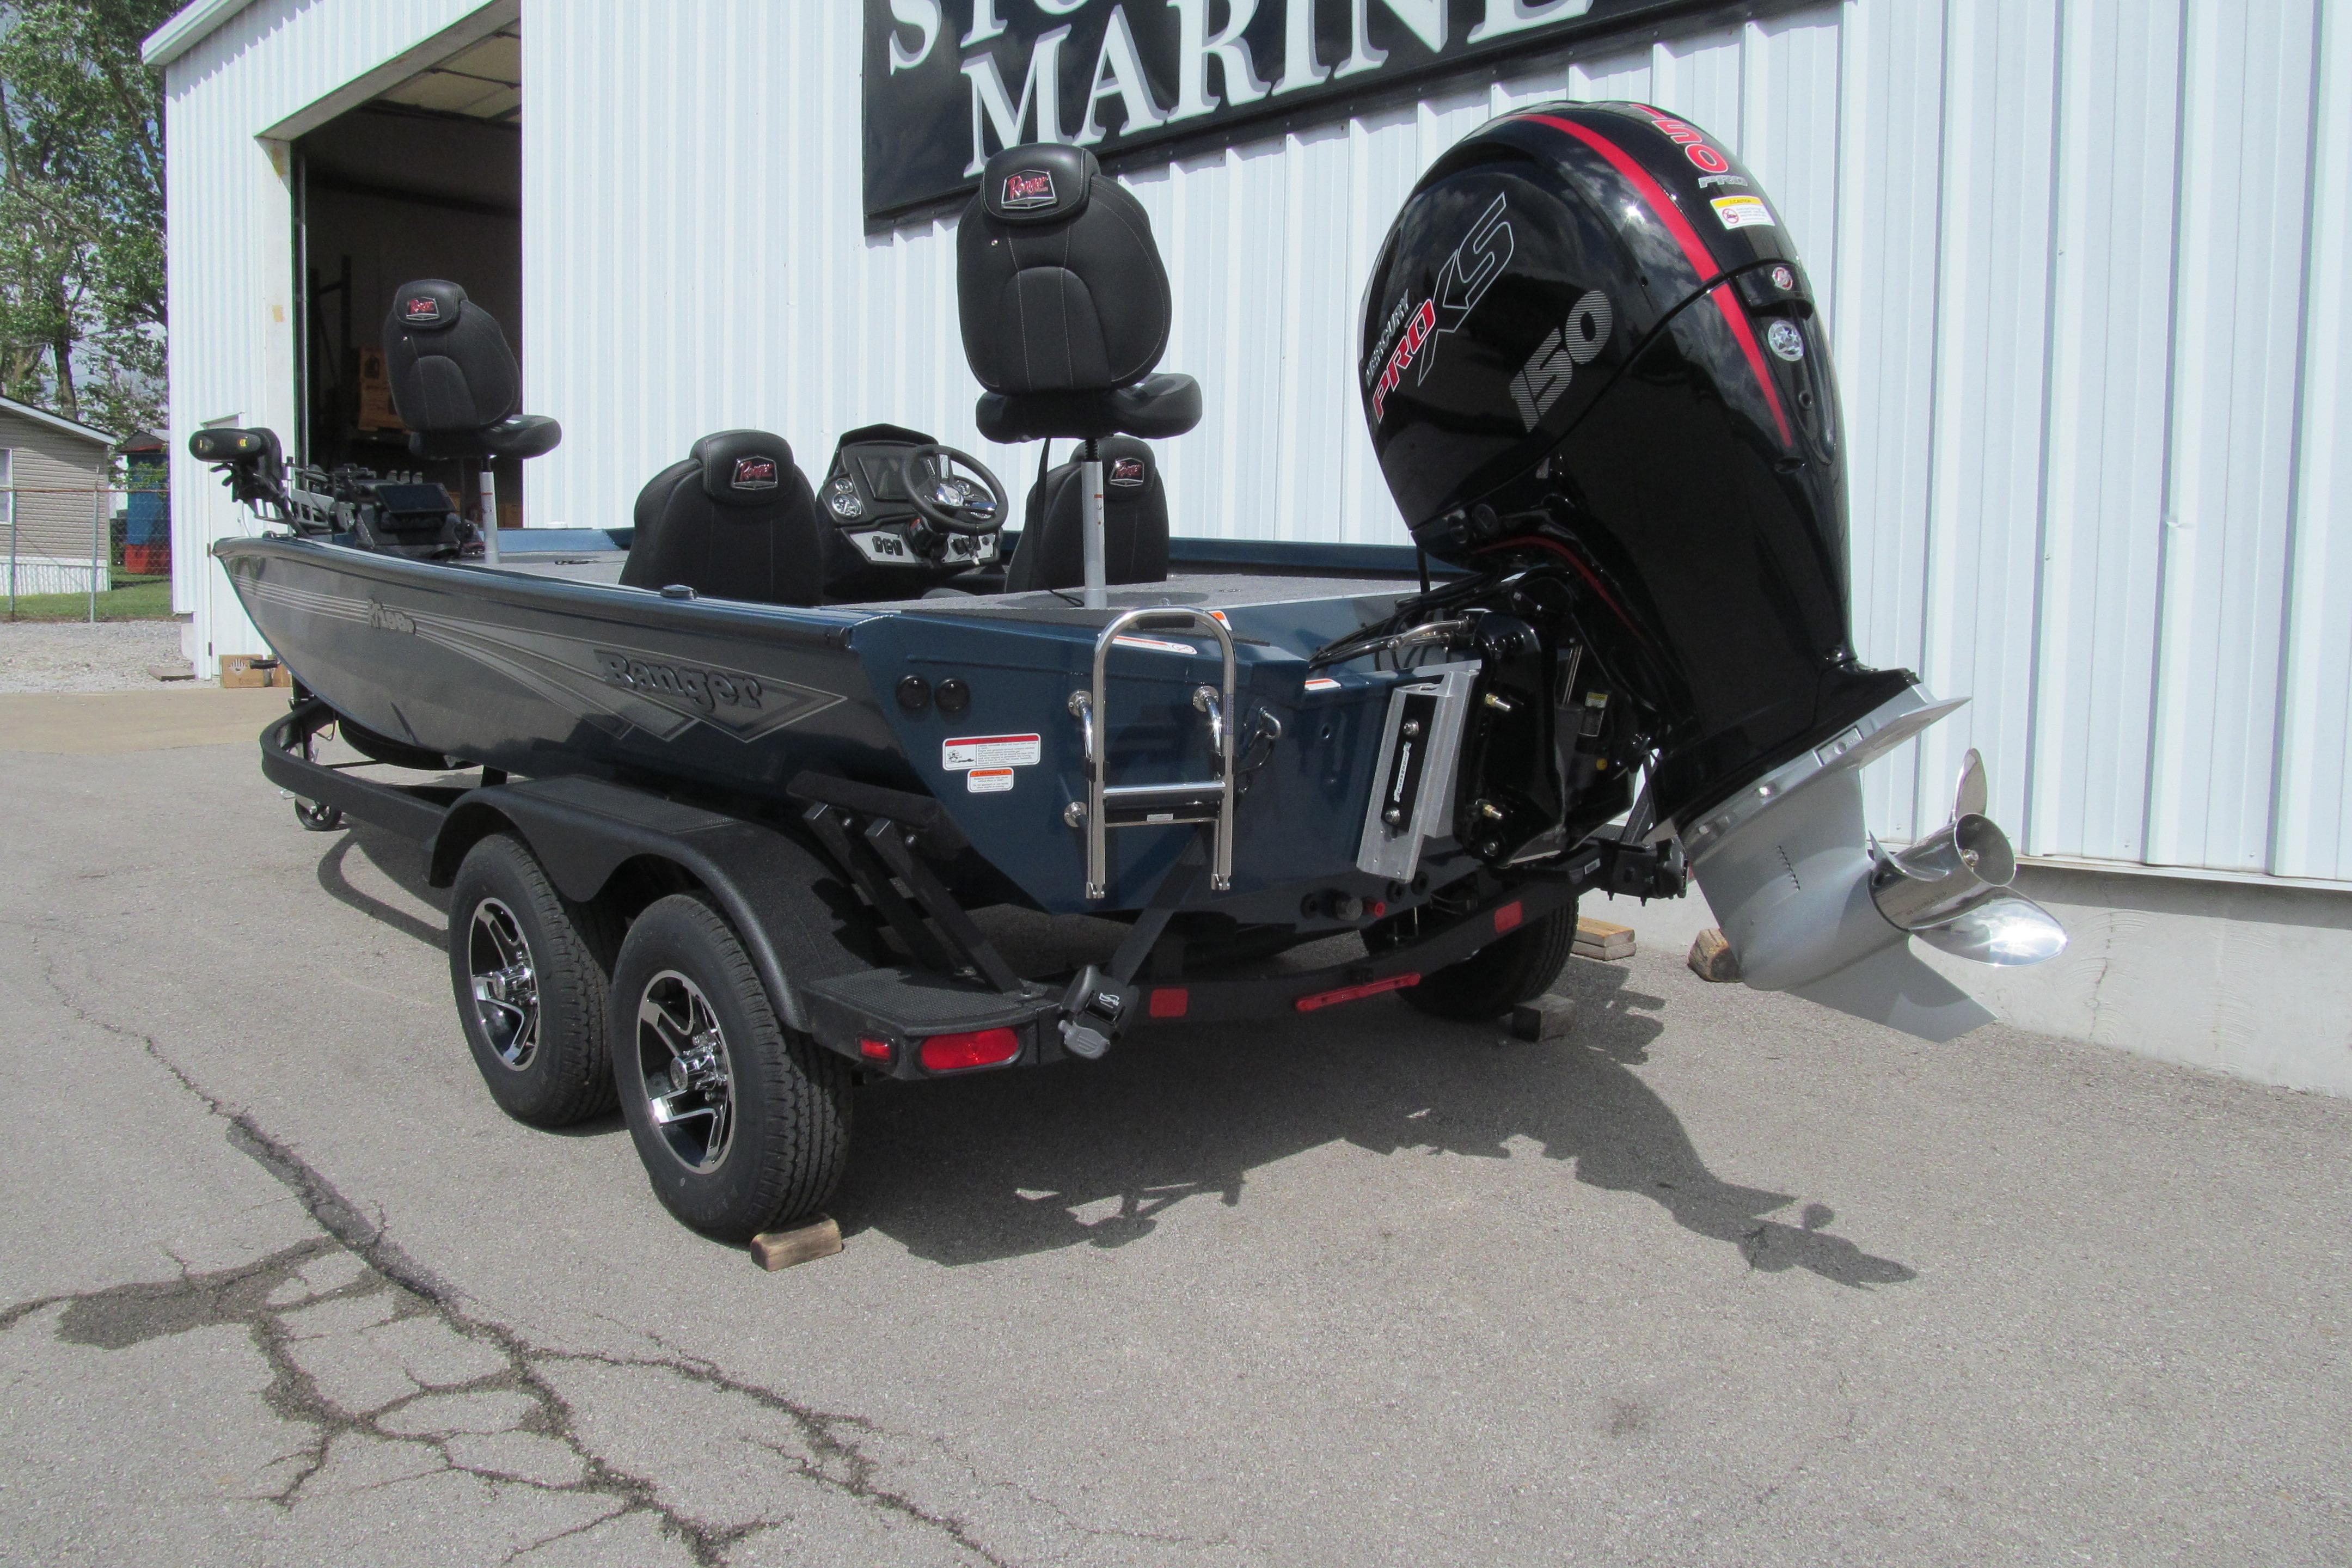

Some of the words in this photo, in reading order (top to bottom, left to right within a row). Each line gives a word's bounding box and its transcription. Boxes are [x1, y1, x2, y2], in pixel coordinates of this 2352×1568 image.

[960, 0, 1594, 178] MARIN
[1365, 288, 1409, 389] MERCURY
[1372, 298, 1436, 424] PRO
[1405, 191, 1514, 387] XS
[1509, 290, 1613, 433] 150
[593, 650, 762, 712] Ranger
